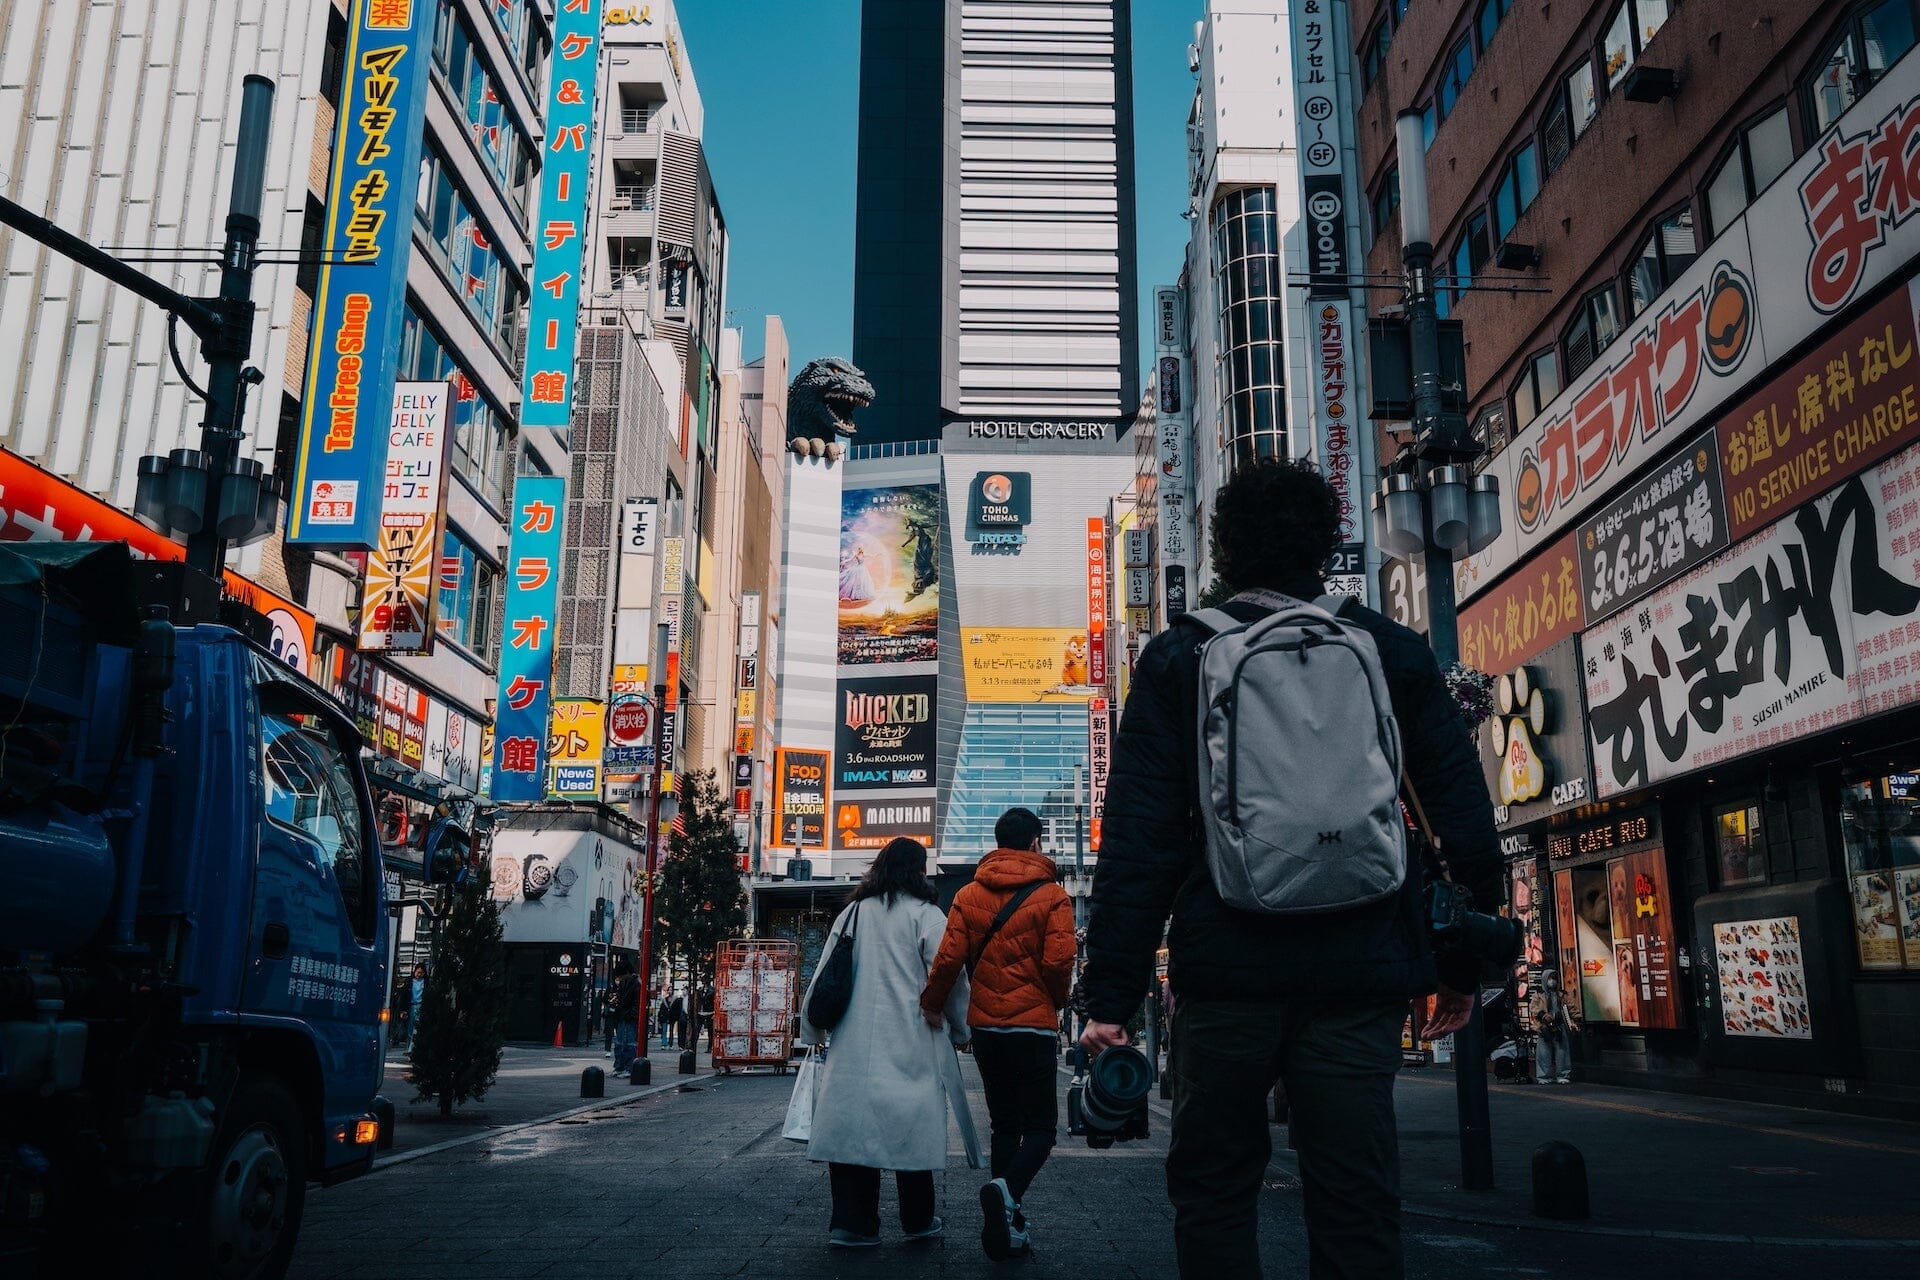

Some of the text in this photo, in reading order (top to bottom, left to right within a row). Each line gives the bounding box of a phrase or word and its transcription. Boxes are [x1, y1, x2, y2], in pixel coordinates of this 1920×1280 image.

[1305, 21, 1326, 84] カプセル
[1310, 103, 1328, 115] 8F
[344, 45, 409, 264] マツモトキヨシ
[1312, 149, 1331, 161] 5F
[1308, 191, 1342, 275] Booth
[342, 294, 372, 352] Shop
[1162, 301, 1175, 341] 東京ビル
[1321, 322, 1347, 402] カラオケ
[336, 352, 368, 407] Free
[394, 395, 437, 409] JELLY
[1538, 286, 1704, 526] カラオケ
[324, 407, 357, 453] Tax
[392, 414, 436, 428] JELLY
[970, 421, 1109, 438] HOTEL GRACERY
[390, 432, 434, 446] CAFE
[1733, 384, 1919, 525] NO SERVICE CHARGE
[386, 461, 432, 477] ジェリ
[384, 483, 429, 498] カフェ
[316, 503, 348, 516] 免税
[982, 506, 1008, 514] TOHO
[982, 514, 1019, 522] CINEMAS
[1331, 553, 1358, 571] 2F
[1462, 556, 1578, 672] 昼から飲める店
[500, 501, 556, 773] カラオケ館
[1589, 475, 1920, 788] すしまみれ
[1586, 607, 1652, 678] 築地海鮮
[1752, 702, 1784, 727] SUSHI
[1785, 670, 1828, 706] MAMIRE
[845, 690, 929, 731] WICKED
[615, 713, 647, 730] 消火栓
[661, 716, 674, 764] AGEHA
[846, 753, 863, 764] 3.6
[875, 754, 925, 763] ROADSHOW
[558, 768, 595, 779] New&
[789, 764, 821, 779] FOD
[843, 770, 889, 783] IMAX
[560, 780, 594, 790] Used
[1551, 776, 1586, 807] CAFE
[866, 806, 931, 825] MARUHAN
[1493, 805, 1510, 827] NU
[1578, 826, 1614, 853] CAFE
[1620, 817, 1648, 843] RIO
[550, 966, 579, 974] OKURA
